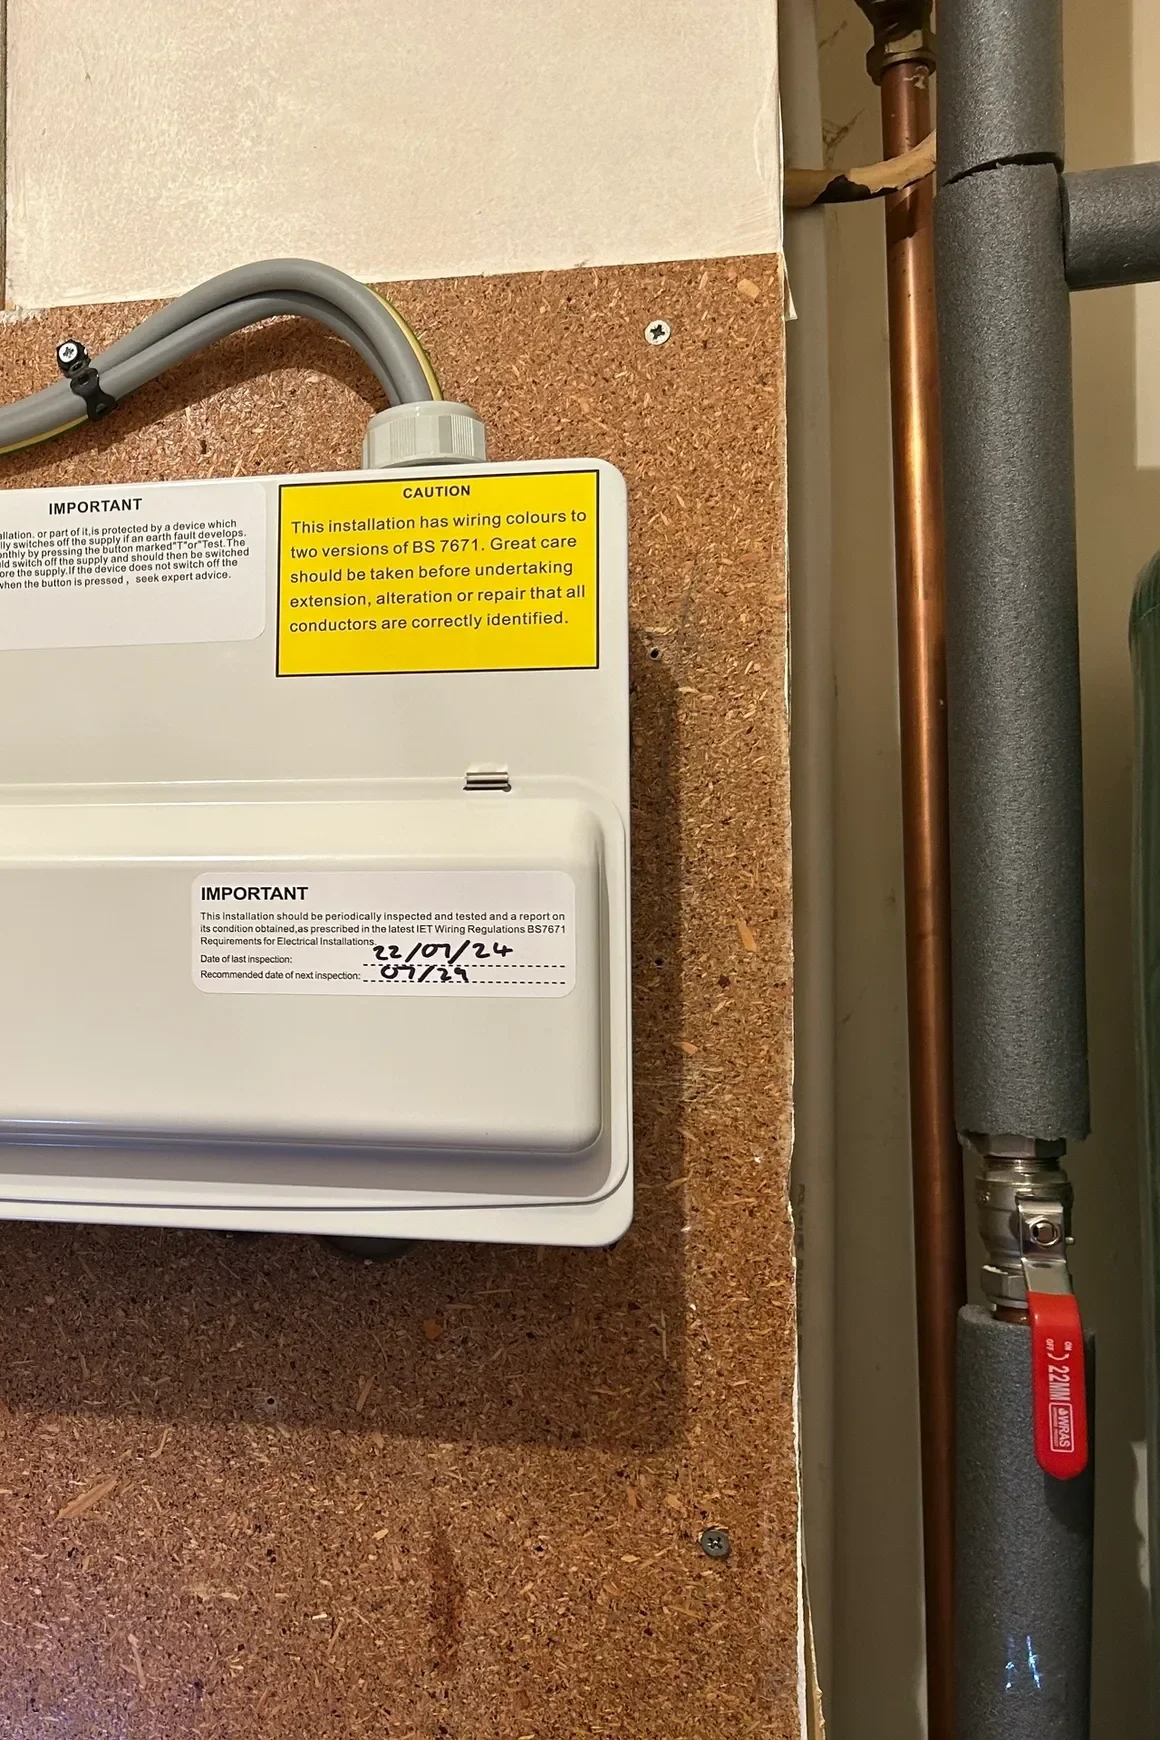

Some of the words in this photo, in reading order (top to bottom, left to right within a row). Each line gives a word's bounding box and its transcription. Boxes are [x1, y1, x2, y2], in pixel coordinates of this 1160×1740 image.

[403, 485, 469, 498] CAUTION
[49, 498, 141, 514] IMPORTANT
[50, 529, 68, 538] part
[70, 528, 81, 536] of
[102, 524, 147, 536] protected
[150, 523, 162, 533] by
[173, 521, 205, 530] device
[207, 519, 236, 528] which
[291, 520, 323, 533] This
[329, 517, 414, 532] installation
[420, 516, 448, 528] has
[452, 514, 500, 528] wiring
[506, 511, 566, 524] colours
[571, 509, 586, 521] to
[290, 546, 317, 558] two
[322, 543, 388, 556] versions
[393, 541, 409, 554] of
[413, 540, 435, 553] BS
[440, 538, 484, 552] 7671.
[490, 536, 536, 550] Great
[540, 537, 576, 548] care
[24, 580, 39, 588] the
[41, 579, 71, 587] button
[74, 577, 82, 585] is
[136, 573, 159, 583] seek
[161, 572, 192, 583] expert
[195, 570, 230, 580] advice.
[290, 569, 341, 583] should
[347, 568, 365, 581] be
[370, 567, 413, 580] taken
[419, 564, 470, 578] before
[475, 560, 572, 576] undertaking
[290, 593, 370, 607] extension,
[376, 590, 451, 604] alteration
[457, 591, 473, 601] or
[478, 587, 525, 603] repair
[530, 586, 561, 599] that
[566, 584, 584, 598] all
[290, 618, 376, 632] conductors
[381, 619, 406, 629] are
[411, 614, 482, 629] correctly
[487, 611, 567, 625] identified.
[202, 887, 308, 900] IMPORTANT
[276, 912, 308, 920] should
[311, 912, 322, 920] be
[325, 912, 381, 922] periodically
[384, 912, 431, 921] inspected
[434, 912, 452, 920] and
[455, 912, 486, 920] tested
[489, 912, 507, 920] and
[519, 912, 549, 921] report
[212, 924, 253, 932] condition
[310, 925, 359, 934] prescribed
[371, 925, 386, 933] the
[388, 925, 414, 933] latest
[416, 925, 432, 933] IET
[434, 925, 465, 935] Wiring
[467, 925, 525, 935] Regulations
[527, 925, 564, 933] BS7671
[200, 936, 261, 946] Requirements
[263, 937, 275, 945] for
[277, 937, 317, 945] Electrical
[200, 954, 219, 962] Date
[221, 954, 230, 962] of
[231, 955, 246, 963] last
[247, 955, 292, 964] inspection:
[372, 940, 514, 964] 22/07/24
[200, 970, 263, 978] Recommended
[264, 970, 283, 978] date
[285, 970, 293, 978] of
[315, 971, 360, 980] inspection:
[1046, 1339, 1054, 1351] OFF
[1064, 1341, 1072, 1350] ON
[1048, 1365, 1070, 1400] 22MM
[1058, 1414, 1070, 1447] WRAS
